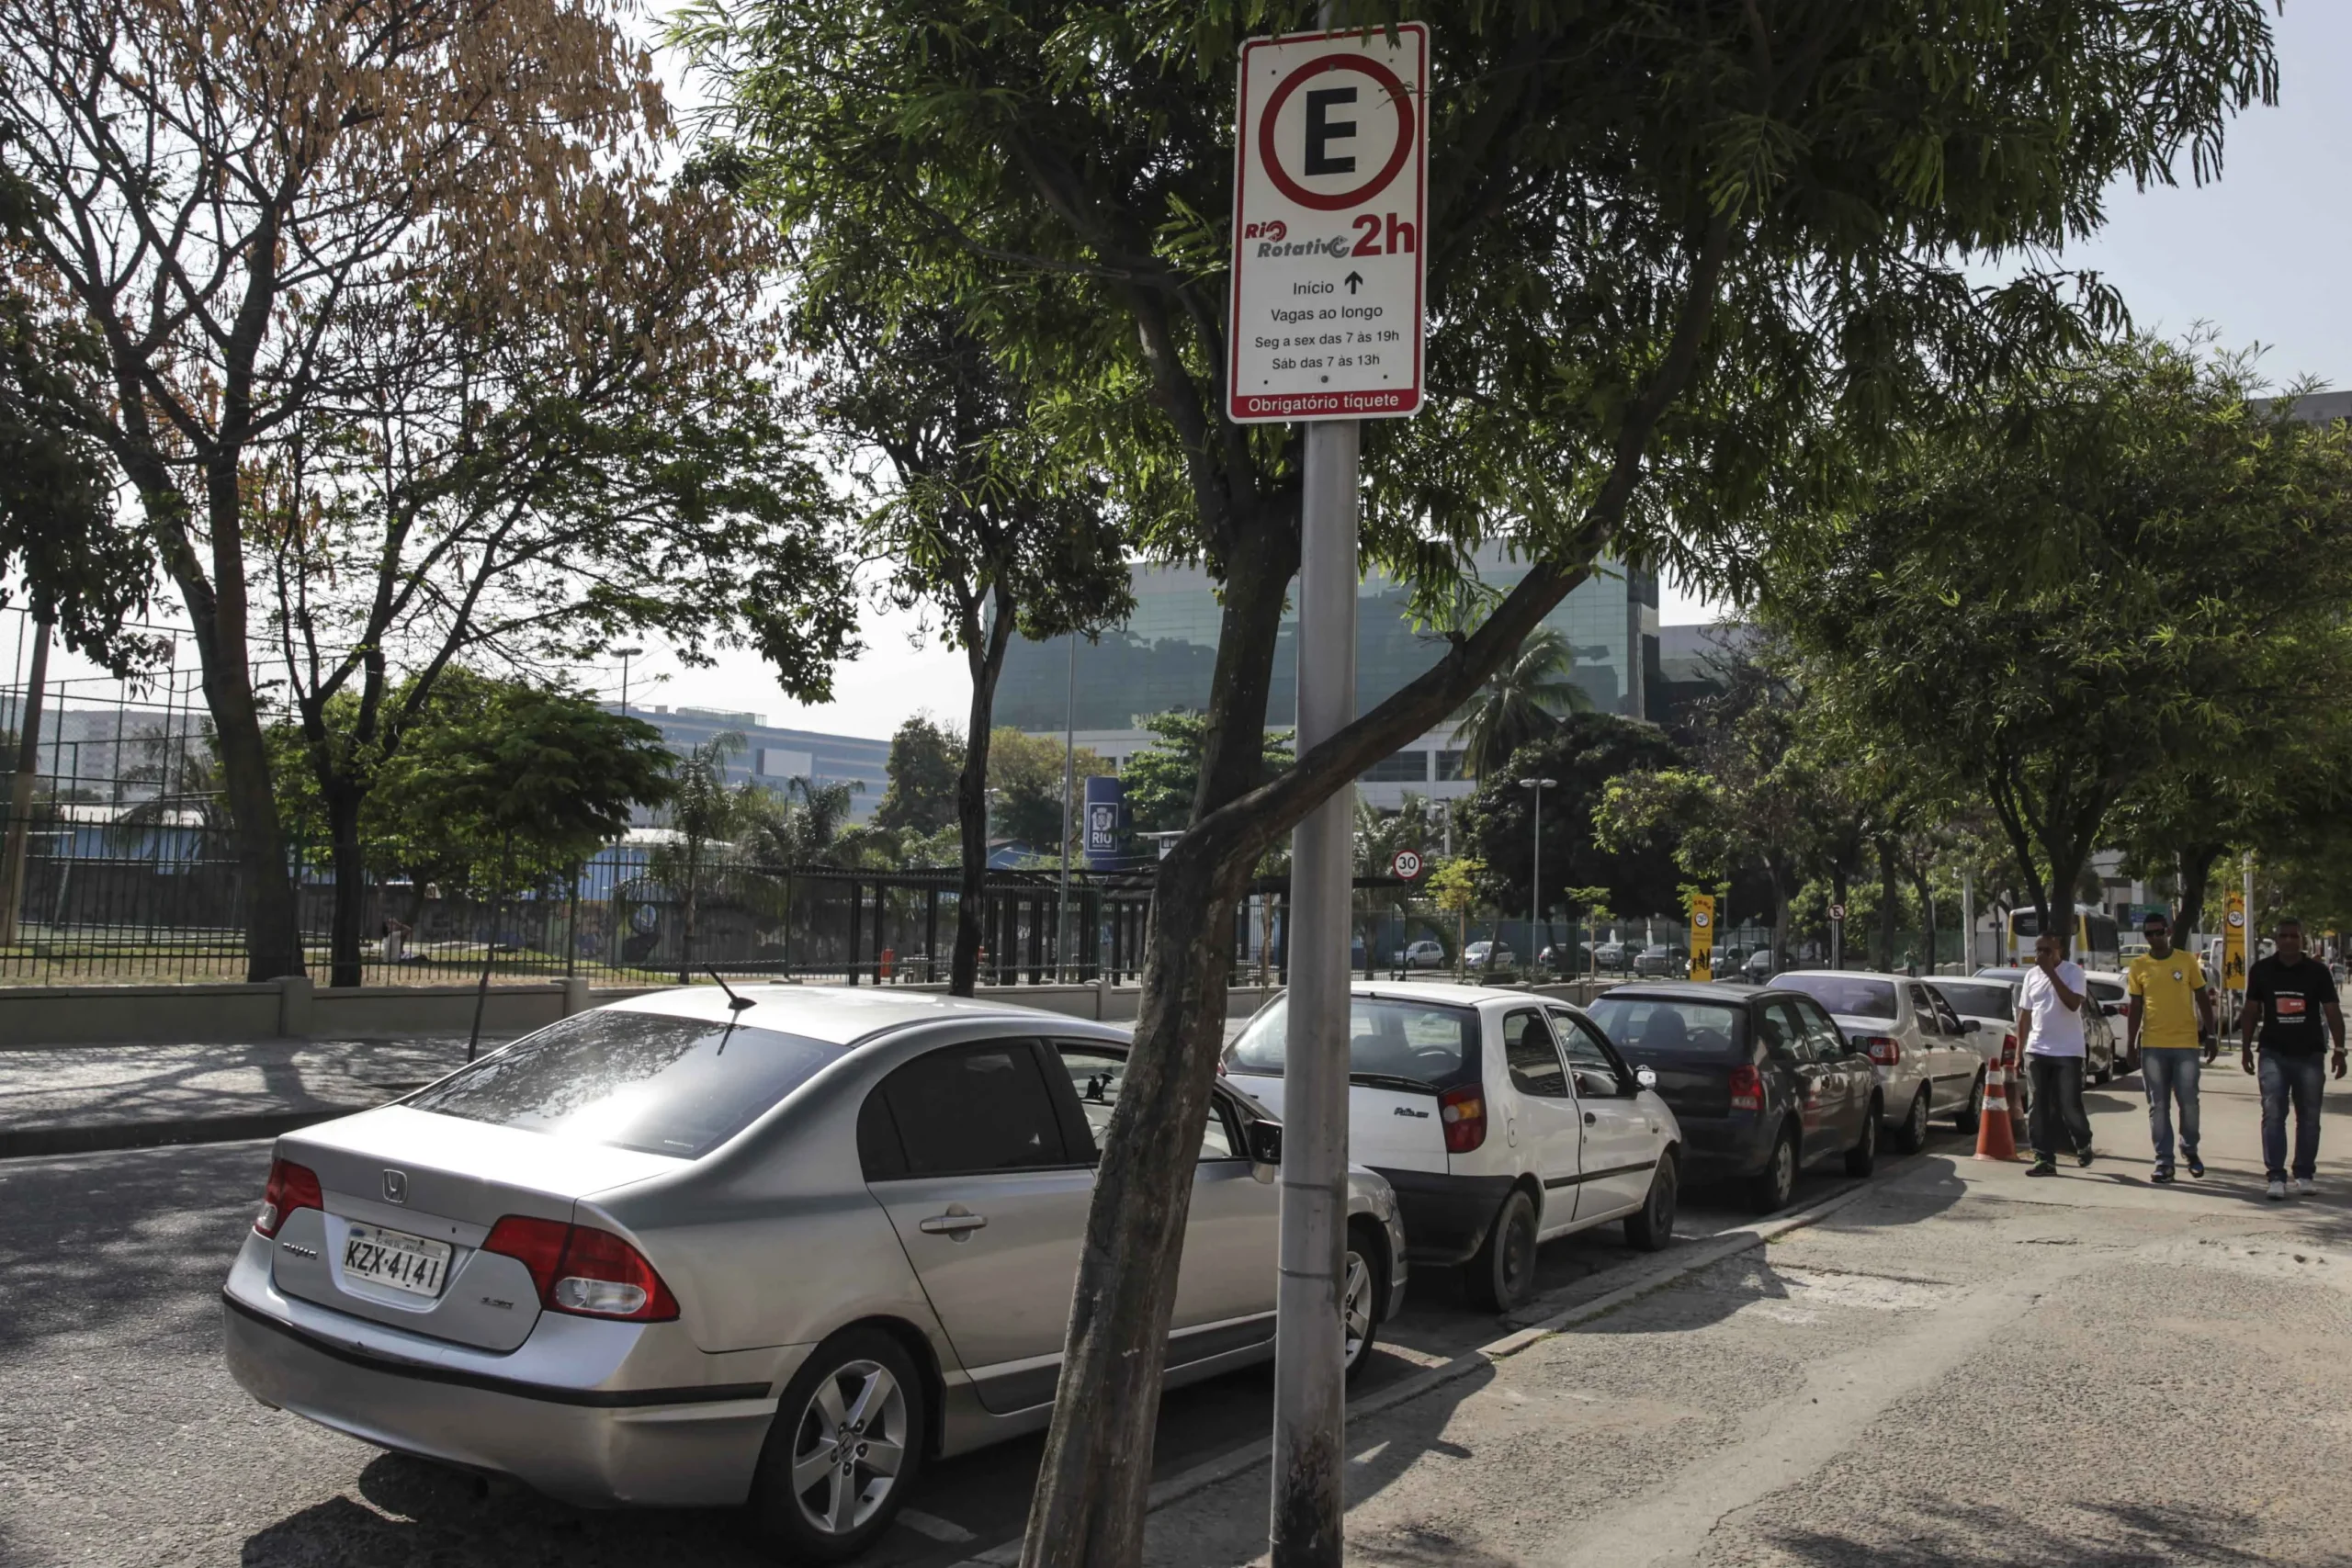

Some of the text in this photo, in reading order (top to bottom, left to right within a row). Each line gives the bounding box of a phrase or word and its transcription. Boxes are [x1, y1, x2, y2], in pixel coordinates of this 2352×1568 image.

[1305, 86, 1357, 176] E
[1351, 212, 1415, 257] 2h
[1293, 280, 1334, 295] Início
[1271, 306, 1383, 323] Vagas ao longo
[1255, 331, 1399, 350] Seg a sex das 7 às 19h
[1272, 354, 1380, 369] Sáb das 7 às 13h
[1248, 393, 1399, 413] Obrigatório tíquete
[1398, 856, 1417, 870] 30
